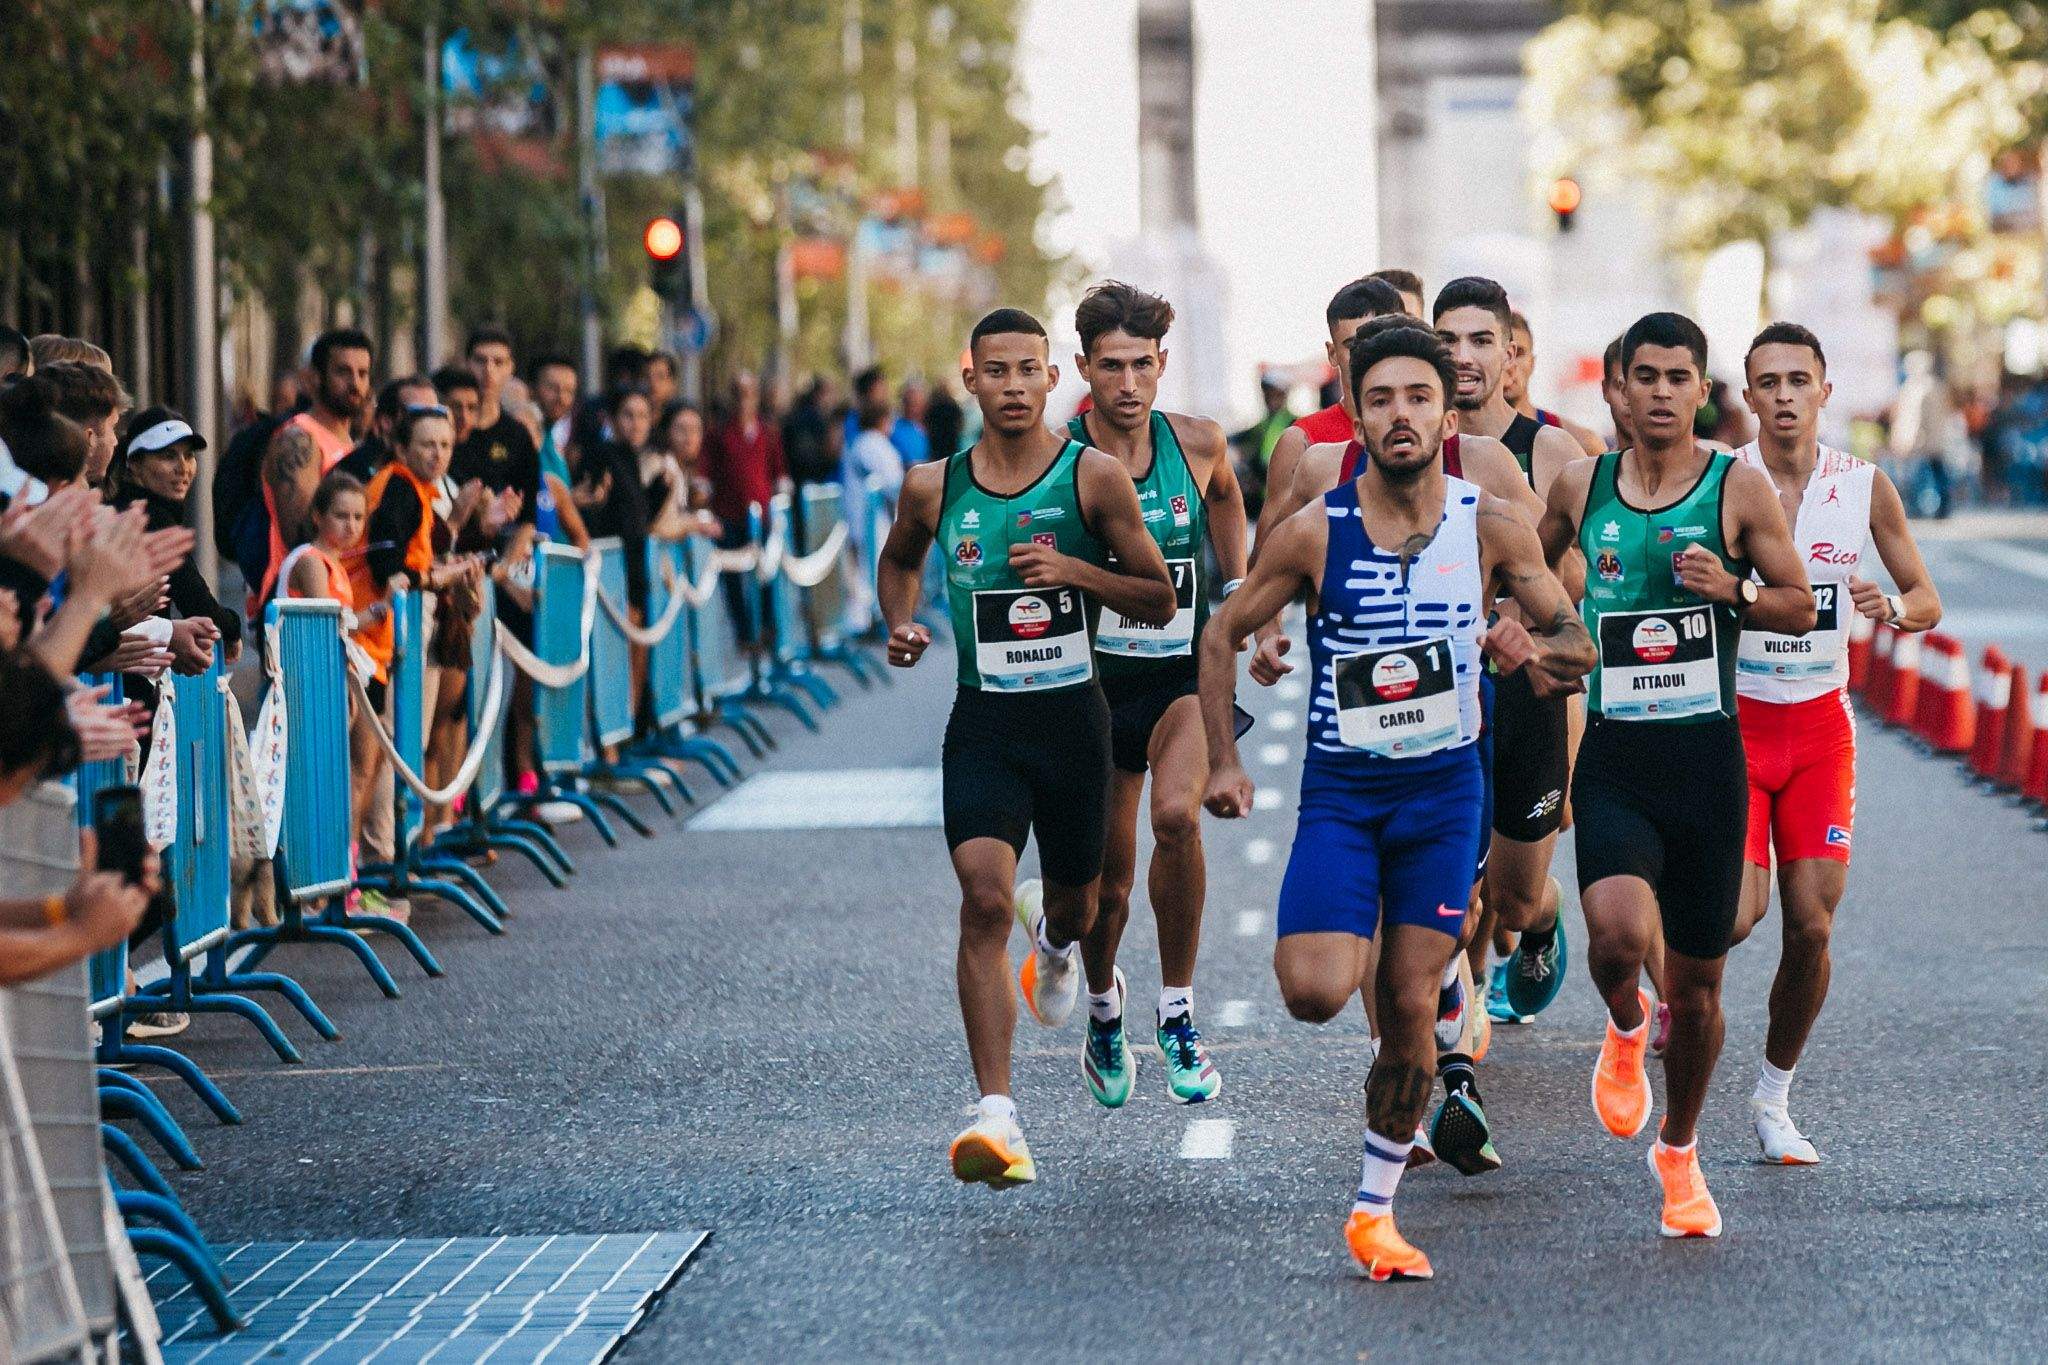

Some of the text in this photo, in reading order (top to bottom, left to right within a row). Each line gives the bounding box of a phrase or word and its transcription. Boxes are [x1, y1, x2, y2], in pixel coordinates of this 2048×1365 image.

[1809, 542, 1858, 565] Rico
[1174, 565, 1185, 589] 7
[1059, 590, 1073, 614] 5
[1813, 587, 1834, 611] 12
[1680, 613, 1707, 640] 10
[1006, 645, 1063, 664] RONALDO
[1764, 640, 1812, 653] VILCHES
[1426, 645, 1440, 672] 1
[1632, 673, 1686, 691] ATTAOUI
[1380, 708, 1425, 729] CARRO
